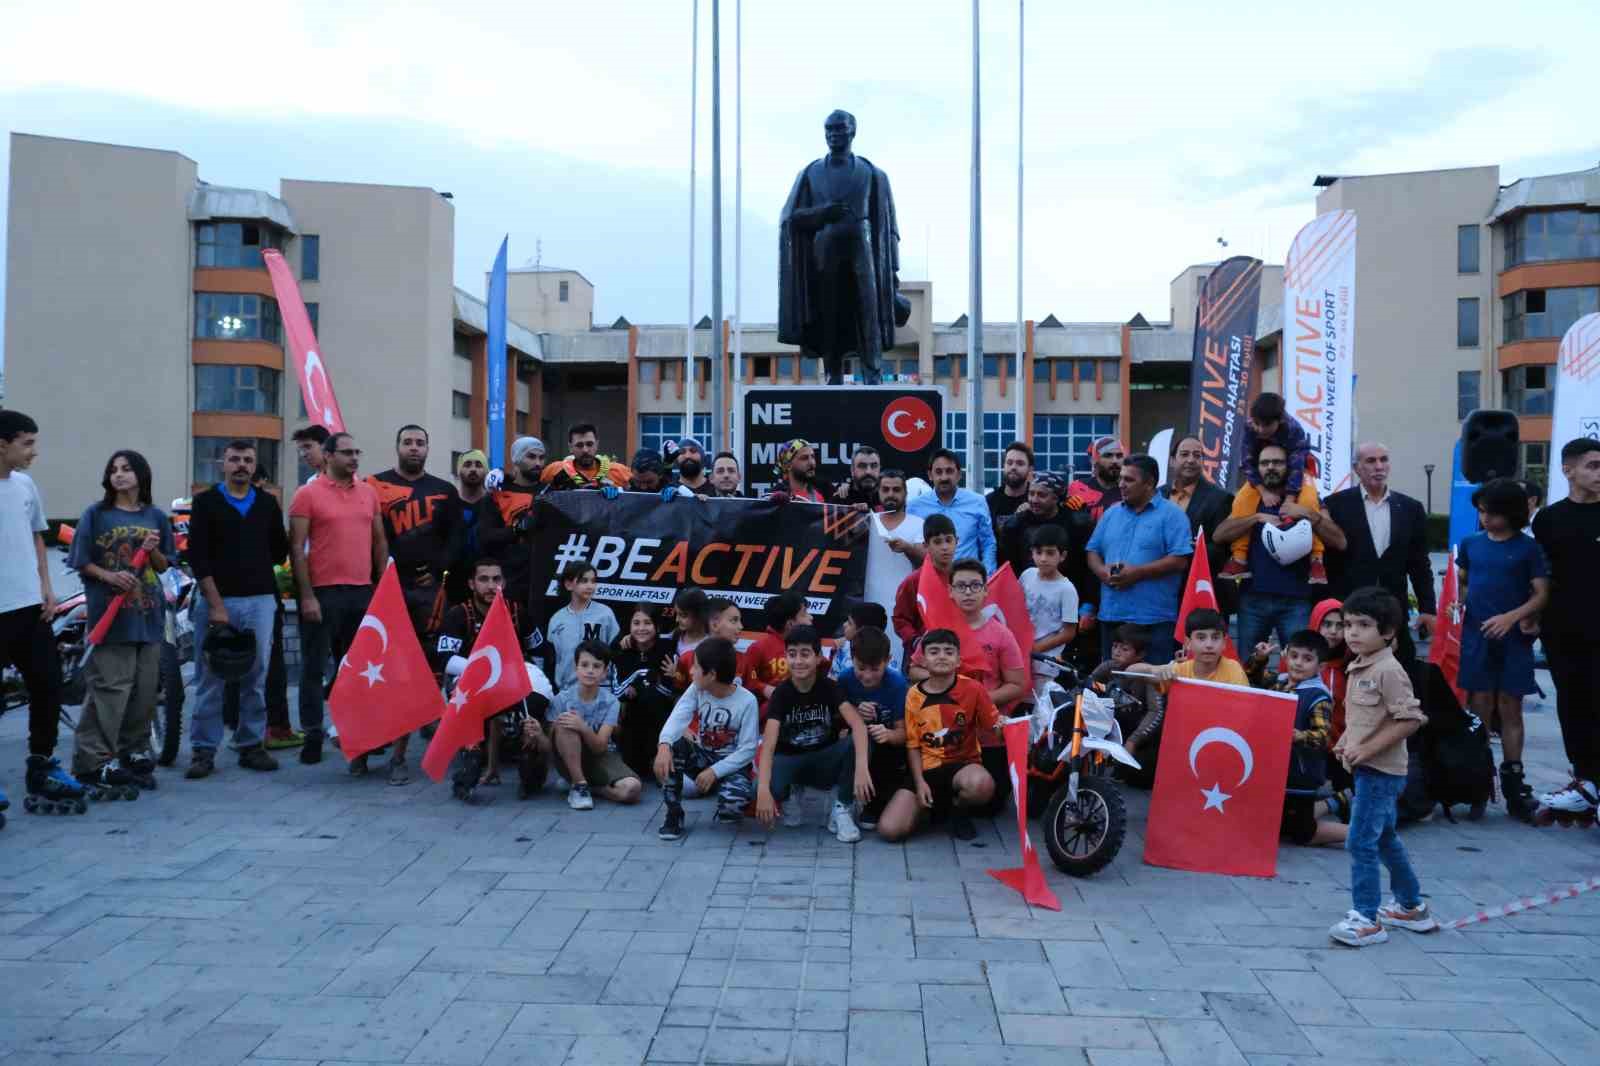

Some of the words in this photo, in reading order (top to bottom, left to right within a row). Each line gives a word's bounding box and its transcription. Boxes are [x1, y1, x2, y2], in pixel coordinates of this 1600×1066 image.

[1325, 289, 1337, 339] SPORT
[1227, 336, 1242, 408] HAFTASI
[1325, 342, 1337, 362] OF
[1326, 365, 1336, 406] WEEK
[751, 403, 792, 425] NE
[1222, 411, 1235, 456] SPOR
[1323, 410, 1335, 491] EUROPEAN
[624, 590, 669, 600] HAFTASI
